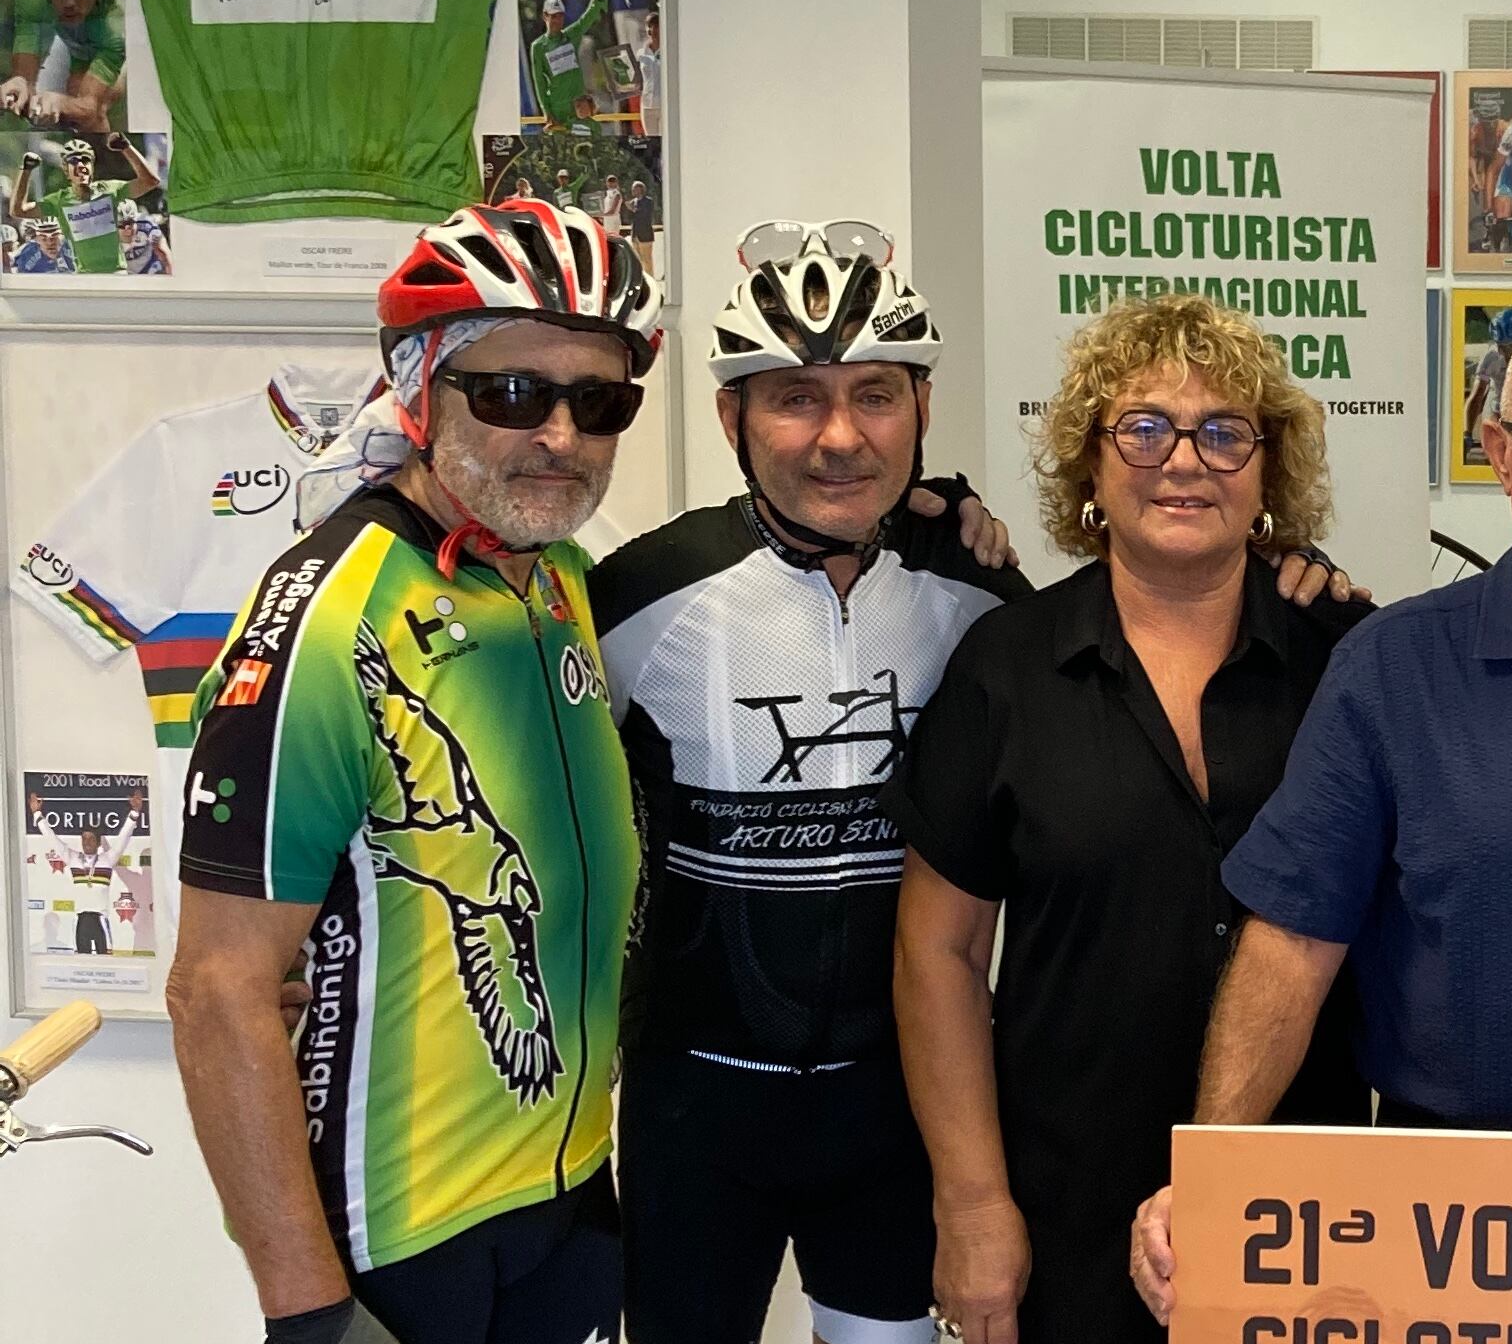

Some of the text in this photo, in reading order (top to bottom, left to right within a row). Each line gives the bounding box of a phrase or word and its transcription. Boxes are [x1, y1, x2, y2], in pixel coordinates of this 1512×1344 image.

[1139, 147, 1282, 199] VOLTA
[1044, 208, 1377, 263] CICLOTURISTA
[1328, 401, 1404, 415] TOGETHER
[262, 558, 326, 651] Aragón
[43, 774, 74, 787] 2001
[79, 775, 111, 788] Road
[719, 824, 835, 851] ARTURO
[1243, 1198, 1376, 1287] 21ª
